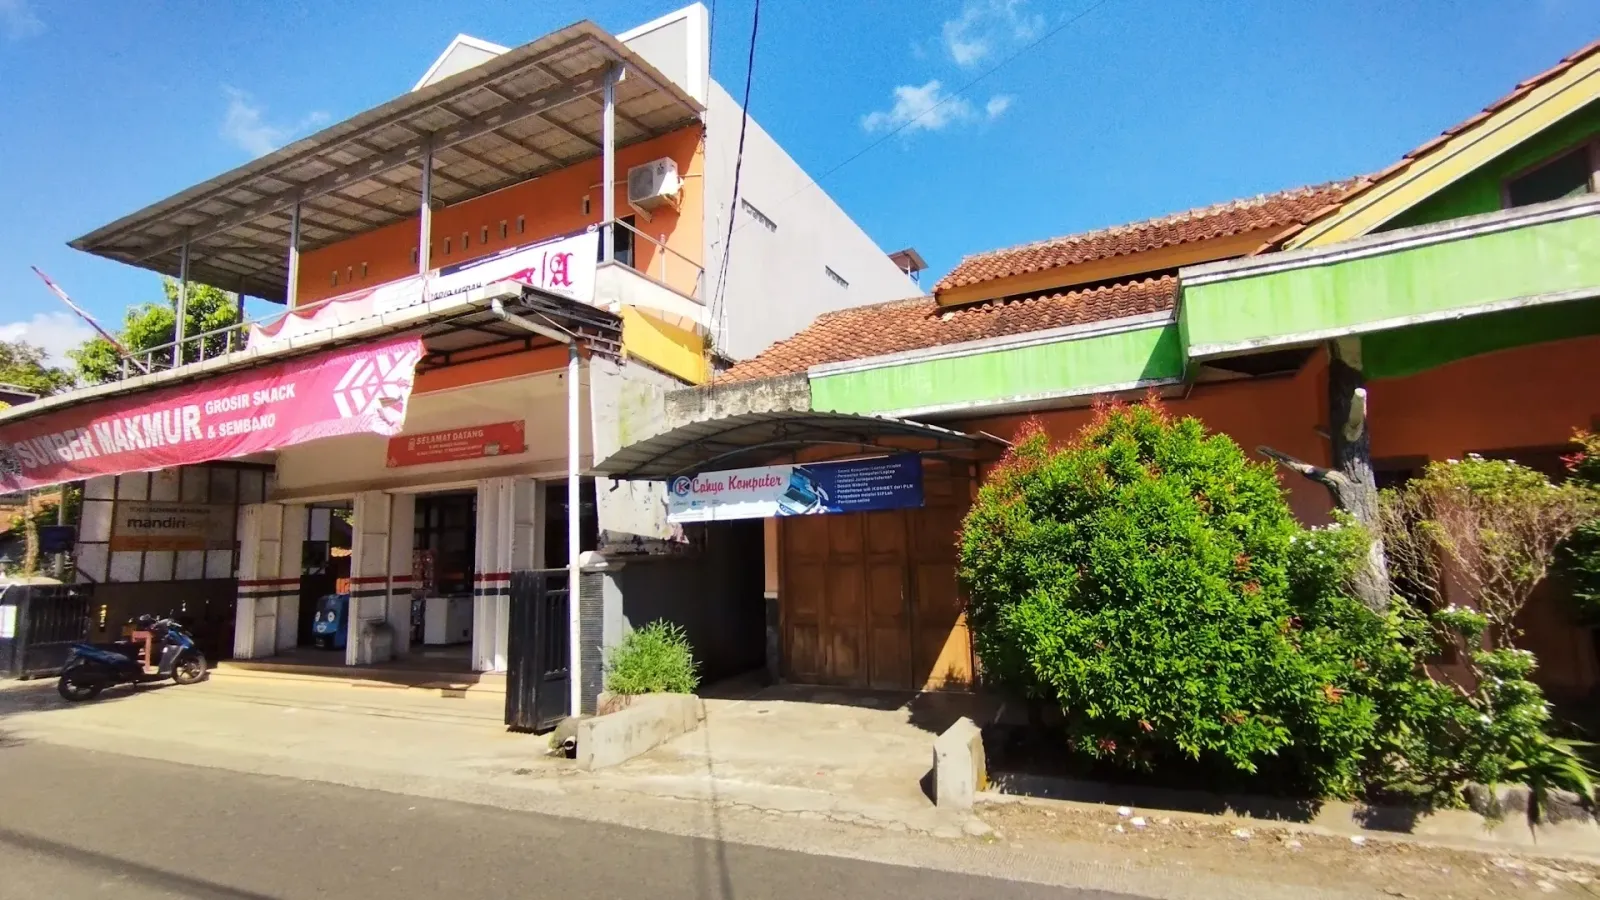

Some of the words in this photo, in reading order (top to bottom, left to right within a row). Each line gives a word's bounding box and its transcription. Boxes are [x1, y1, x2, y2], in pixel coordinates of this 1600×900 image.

[205, 393, 250, 415] GROSIR
[252, 383, 296, 406] SNACK
[15, 426, 101, 470] SUMBER
[93, 404, 203, 455] MAKMUR
[207, 424, 216, 439] &
[218, 413, 276, 437] SEMBAKO
[415, 433, 452, 445] SELAMAT
[452, 429, 485, 441] DATANG
[692, 478, 725, 495] Cahya
[728, 473, 783, 492] Komputer
